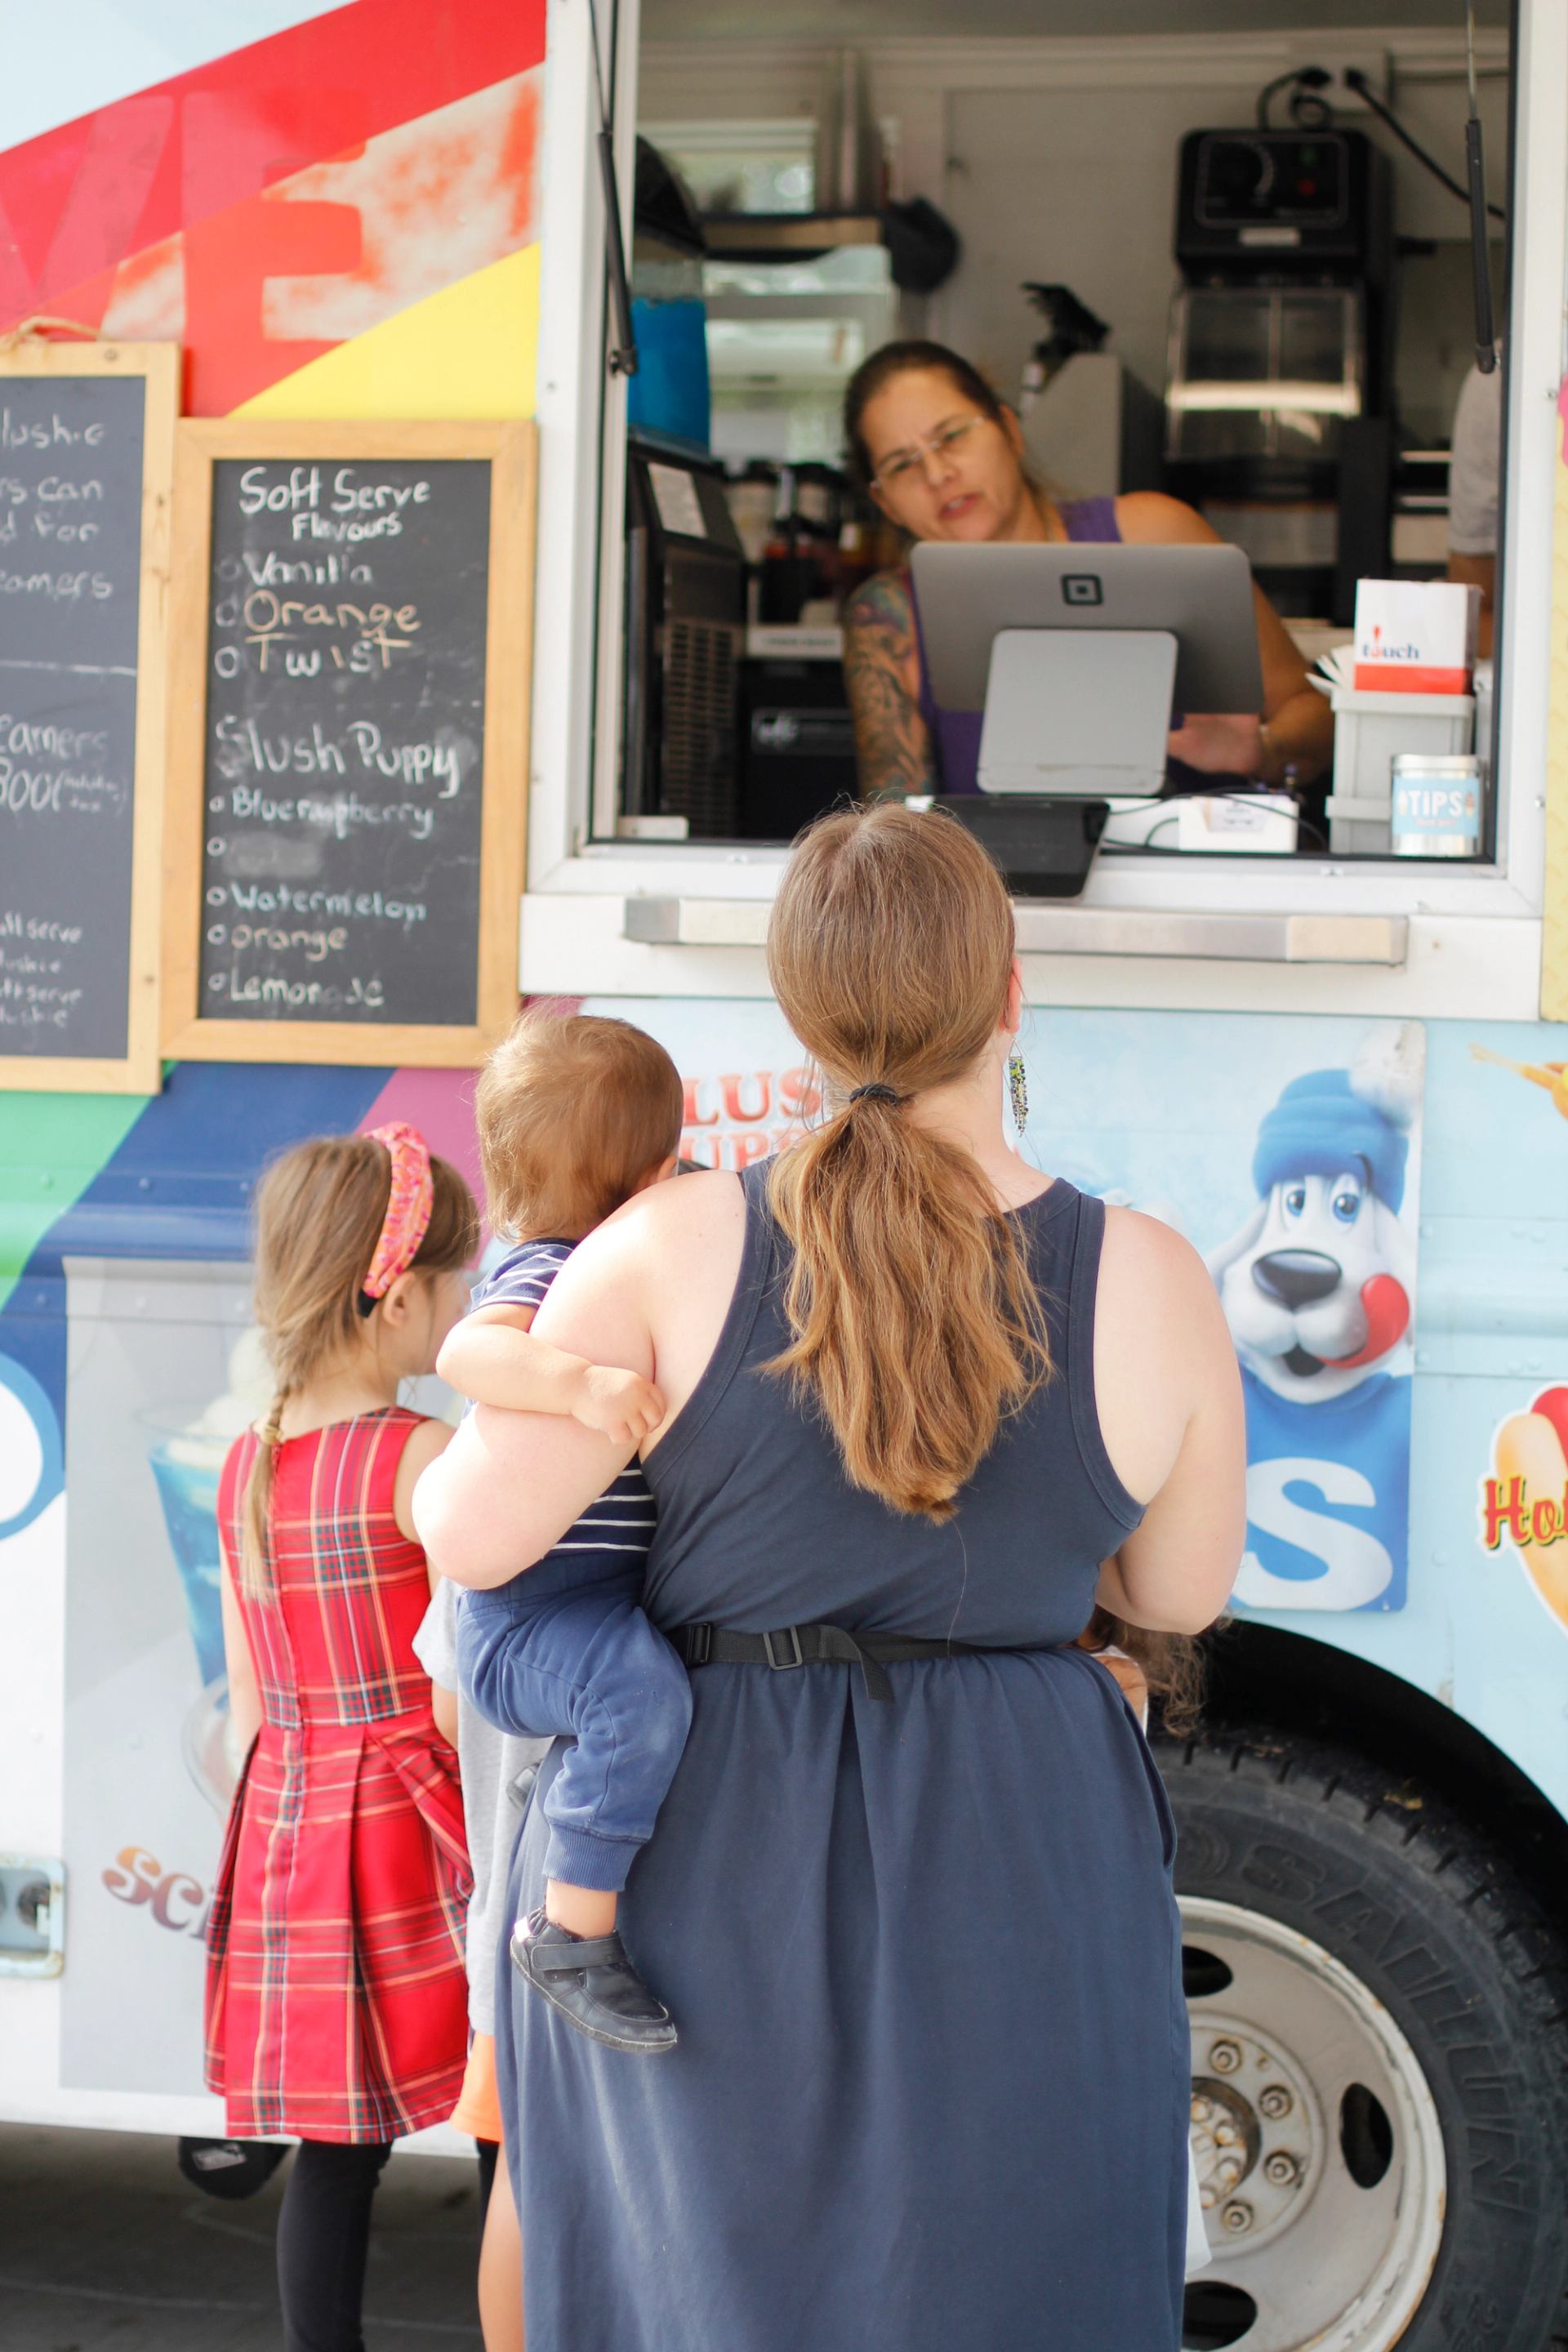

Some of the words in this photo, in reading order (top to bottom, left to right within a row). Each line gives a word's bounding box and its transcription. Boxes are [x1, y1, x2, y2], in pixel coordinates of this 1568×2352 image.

[239, 466, 321, 514] Soft
[330, 468, 432, 512] Serve
[292, 511, 403, 541] Flavours
[243, 589, 422, 639] Orange
[216, 713, 346, 777] Slush
[346, 720, 460, 800] Puppy
[1407, 790, 1463, 817] TIPS
[229, 881, 427, 931] Watermelon
[1482, 1473, 1568, 1550] Ho
[1237, 1839, 1544, 2215] SAILUN
